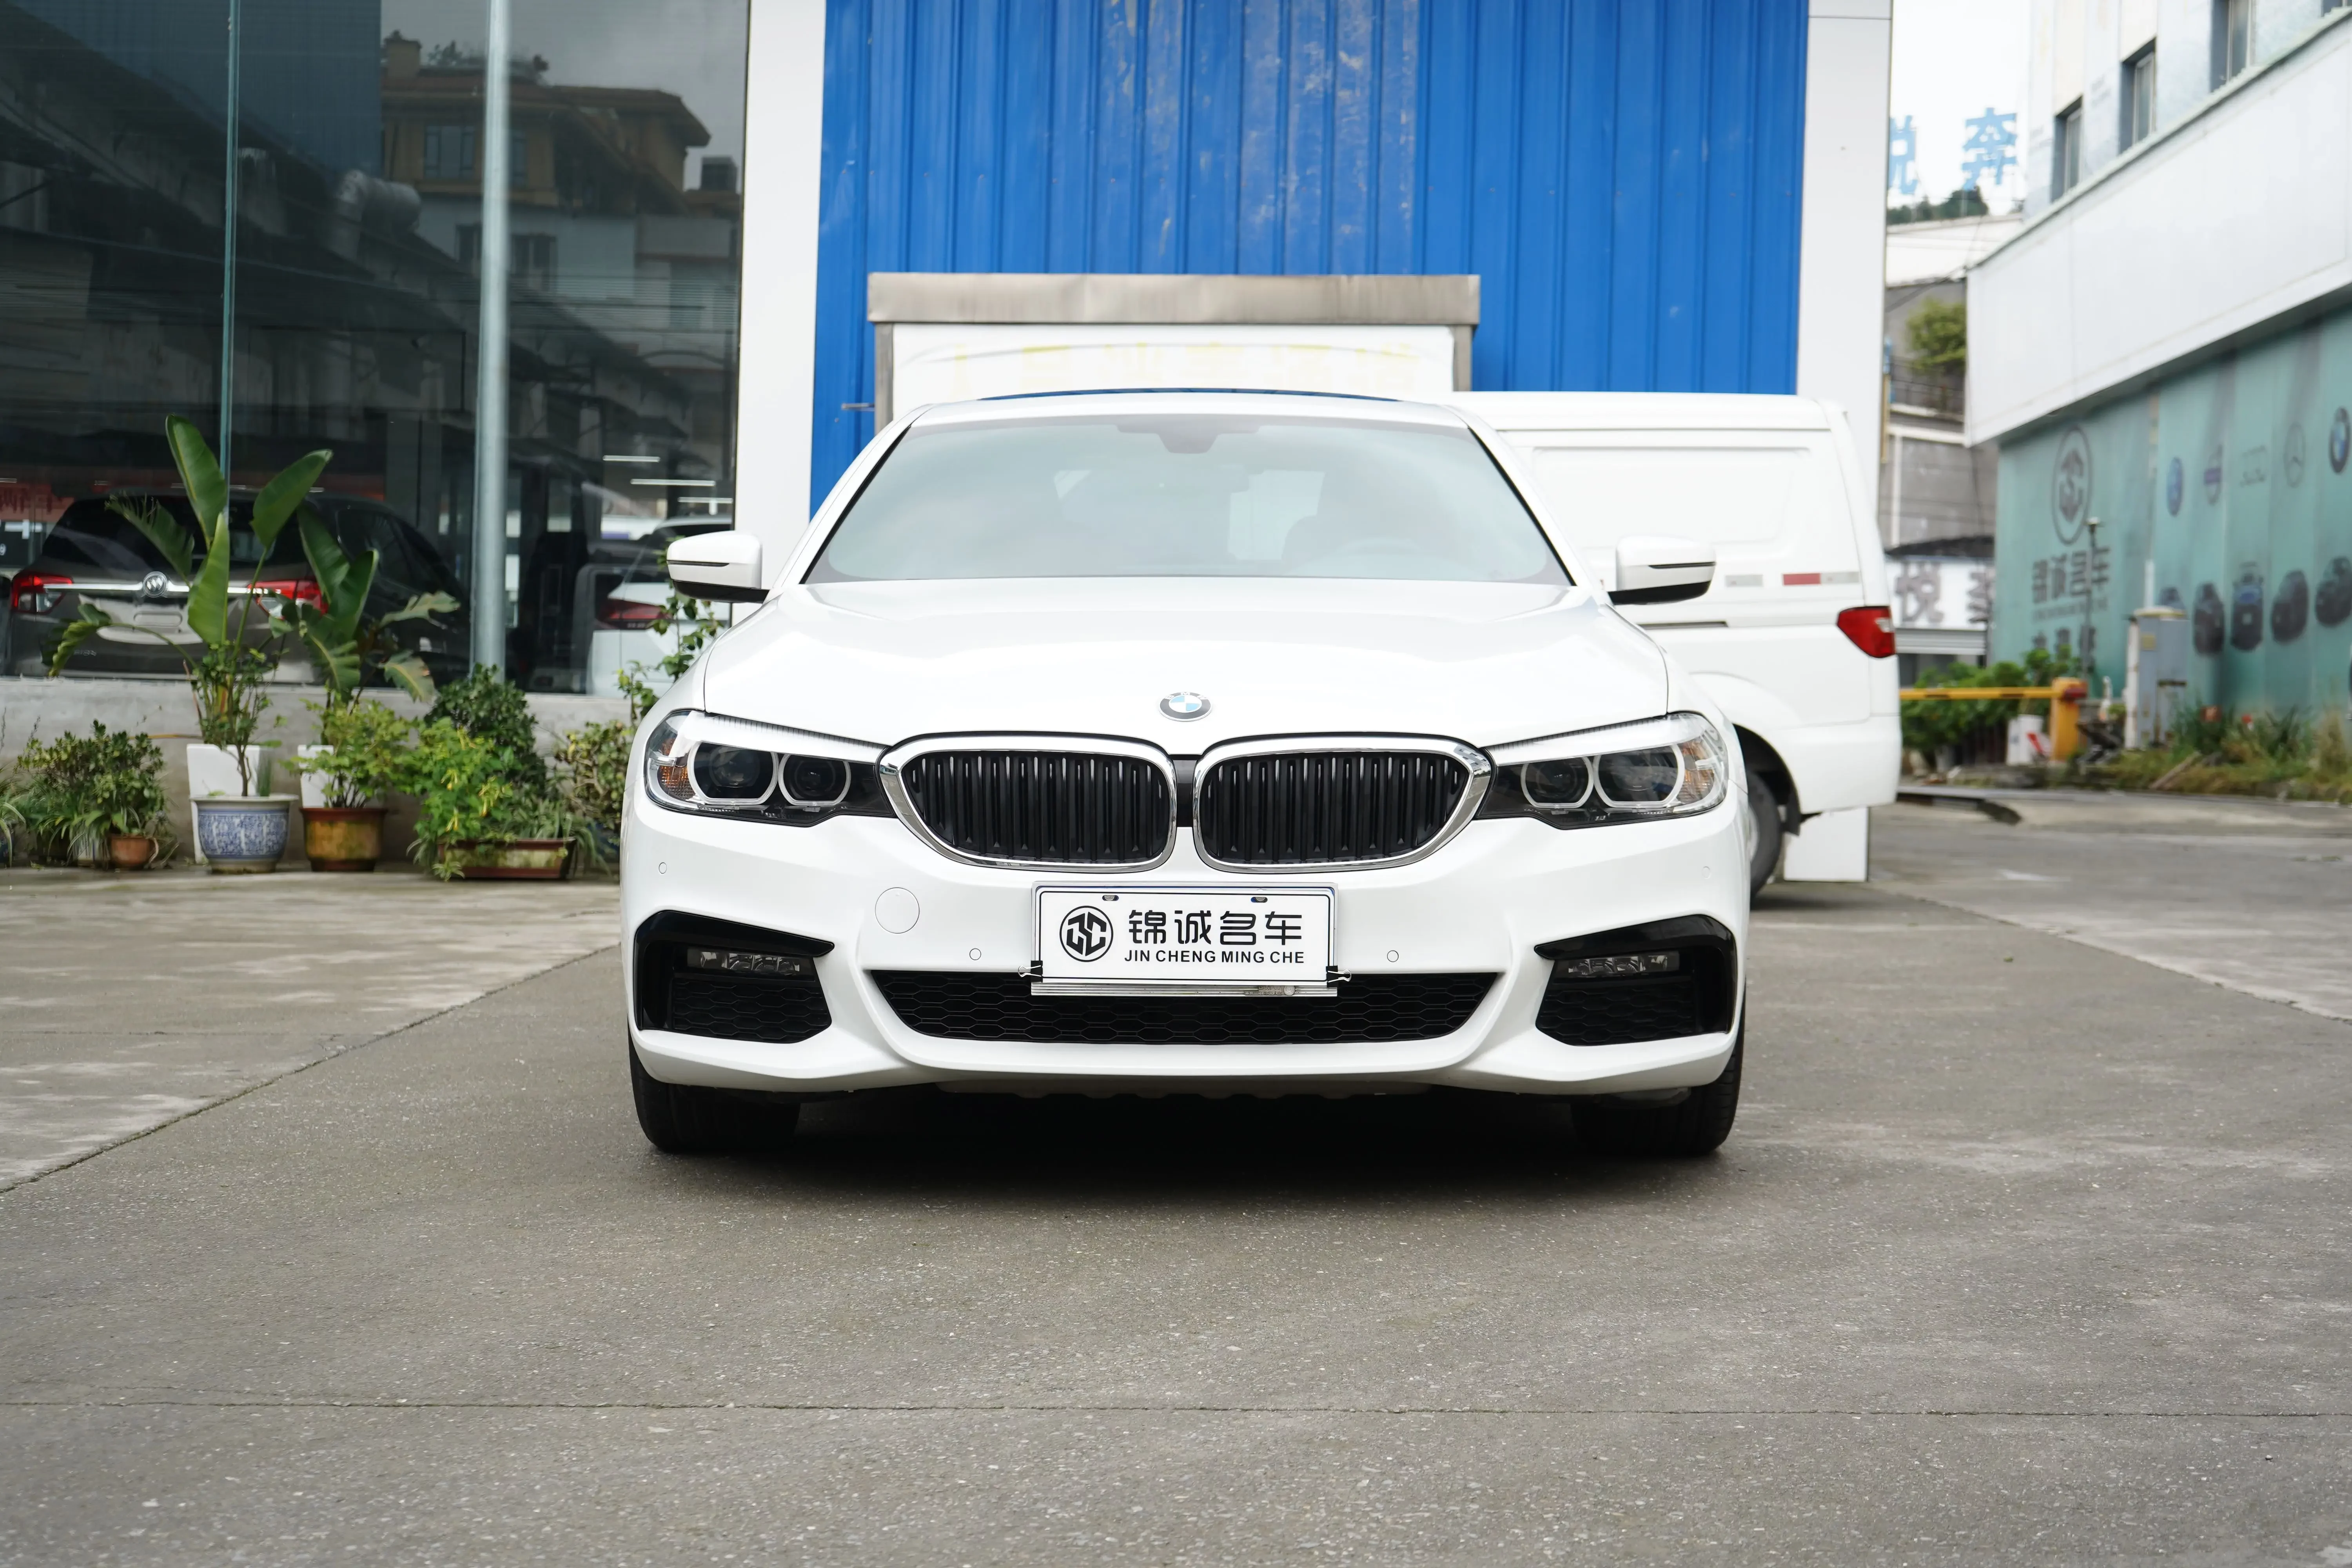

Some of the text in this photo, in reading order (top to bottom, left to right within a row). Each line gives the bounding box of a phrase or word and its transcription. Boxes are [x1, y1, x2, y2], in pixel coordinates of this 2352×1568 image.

[1129, 910, 1301, 945] 锦诚名车
[1125, 950, 1303, 963] JIN CHENG MING CHE
